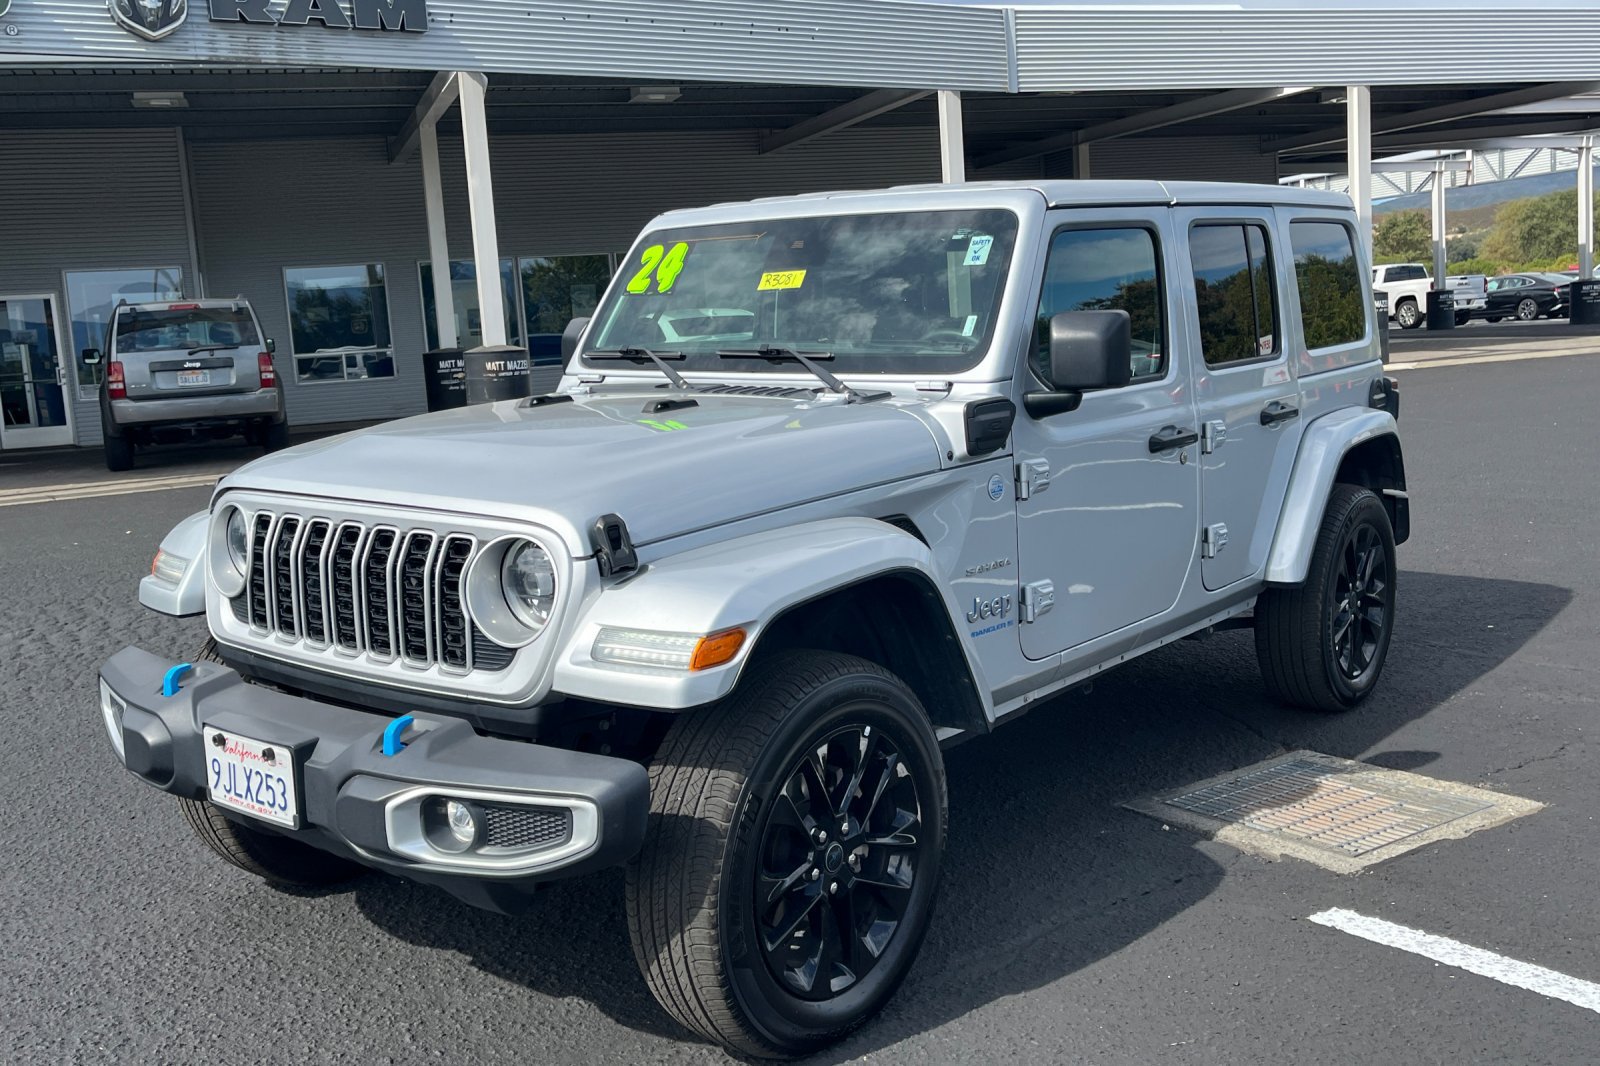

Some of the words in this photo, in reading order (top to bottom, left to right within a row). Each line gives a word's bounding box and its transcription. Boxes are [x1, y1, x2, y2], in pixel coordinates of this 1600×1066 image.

[626, 242, 689, 294] 24
[183, 361, 201, 369] Jeep
[439, 360, 456, 369] MATT
[485, 361, 505, 371] MATT
[966, 593, 1012, 624] Jeep
[212, 758, 287, 811] 9JLX253
